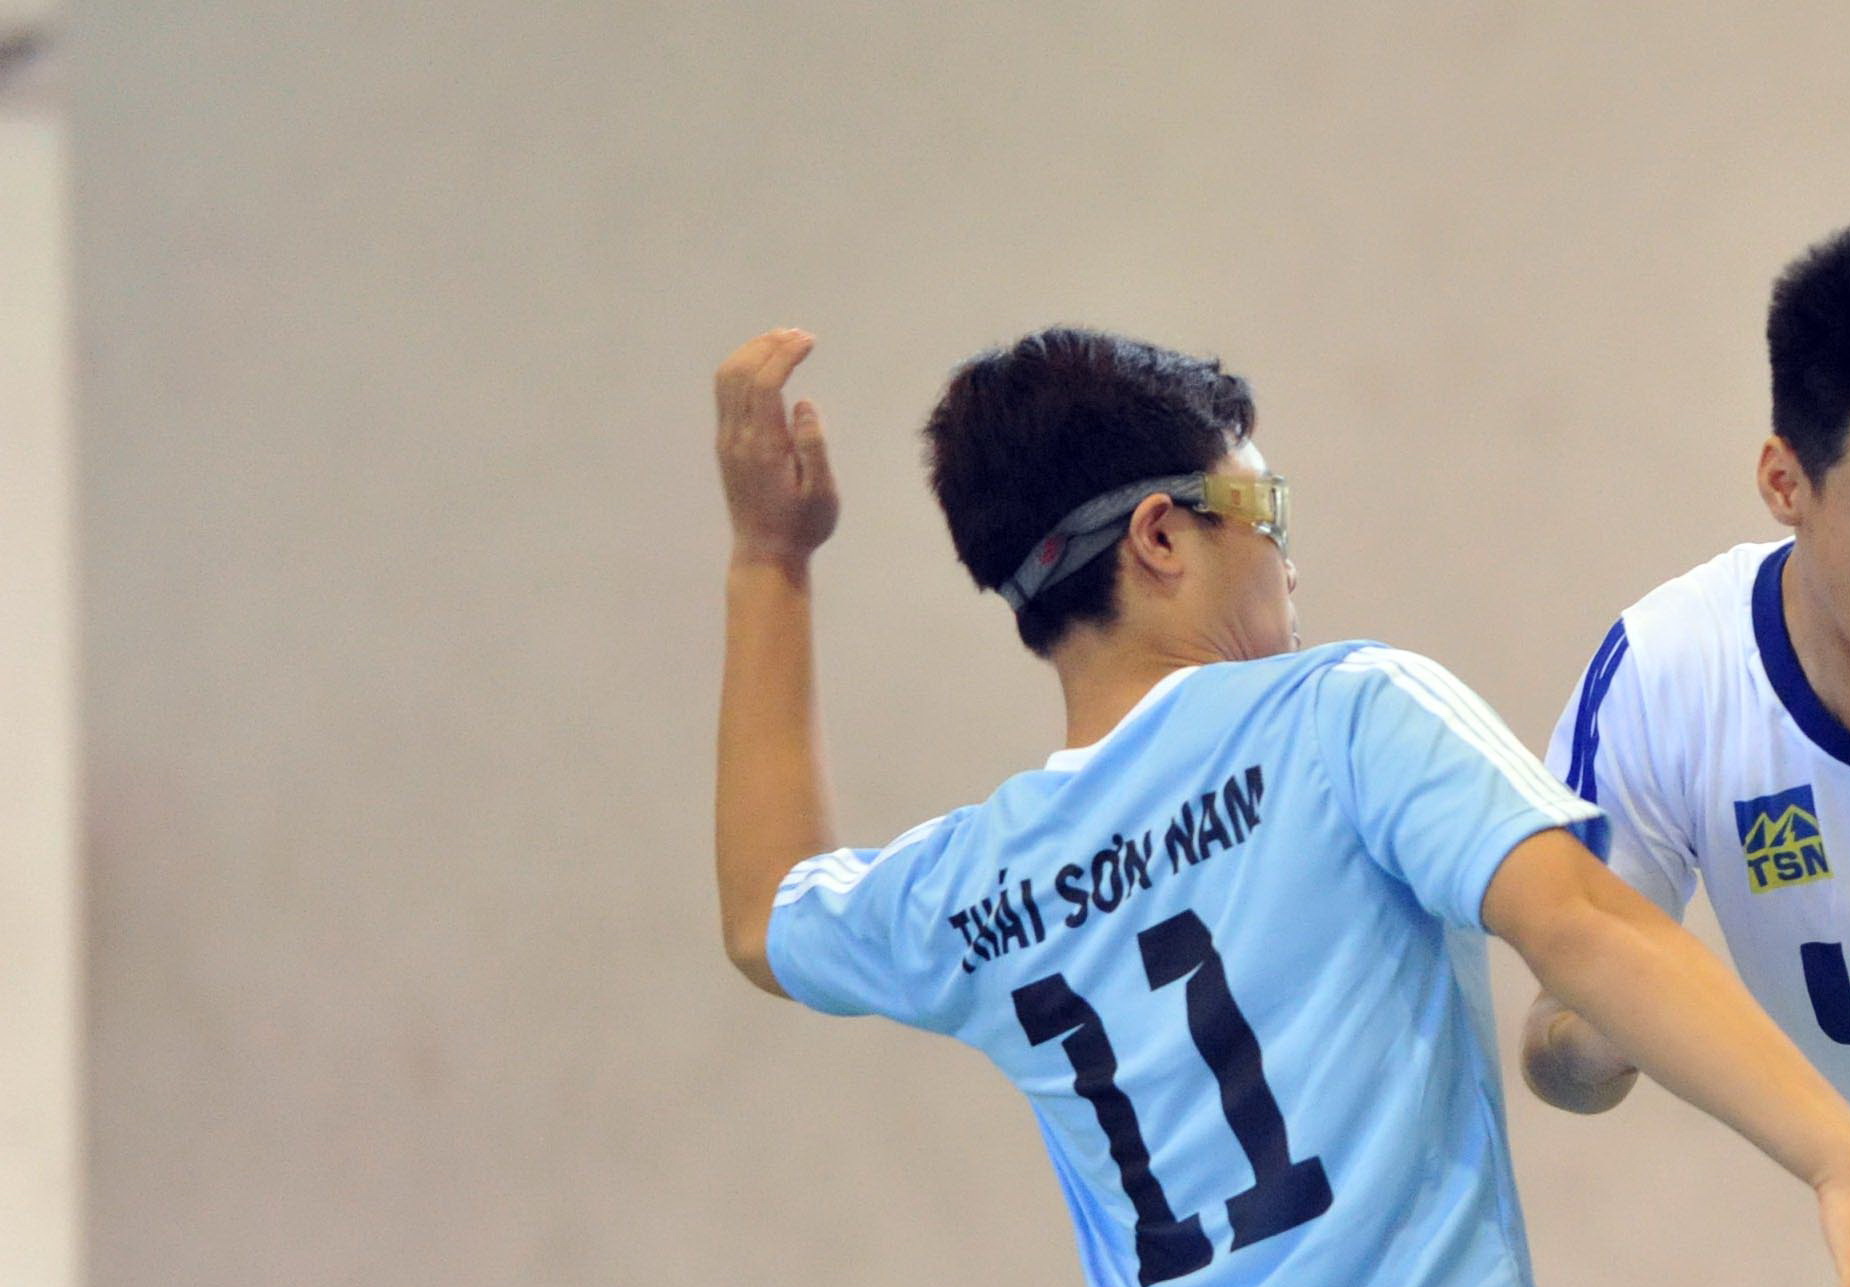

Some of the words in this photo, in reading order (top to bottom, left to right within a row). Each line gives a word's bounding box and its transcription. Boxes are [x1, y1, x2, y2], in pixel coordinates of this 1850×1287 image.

[949, 867, 1046, 974] THÁI
[1055, 834, 1153, 928] SƠN
[1165, 765, 1263, 874] NAM
[1747, 842, 1829, 887] TSN
